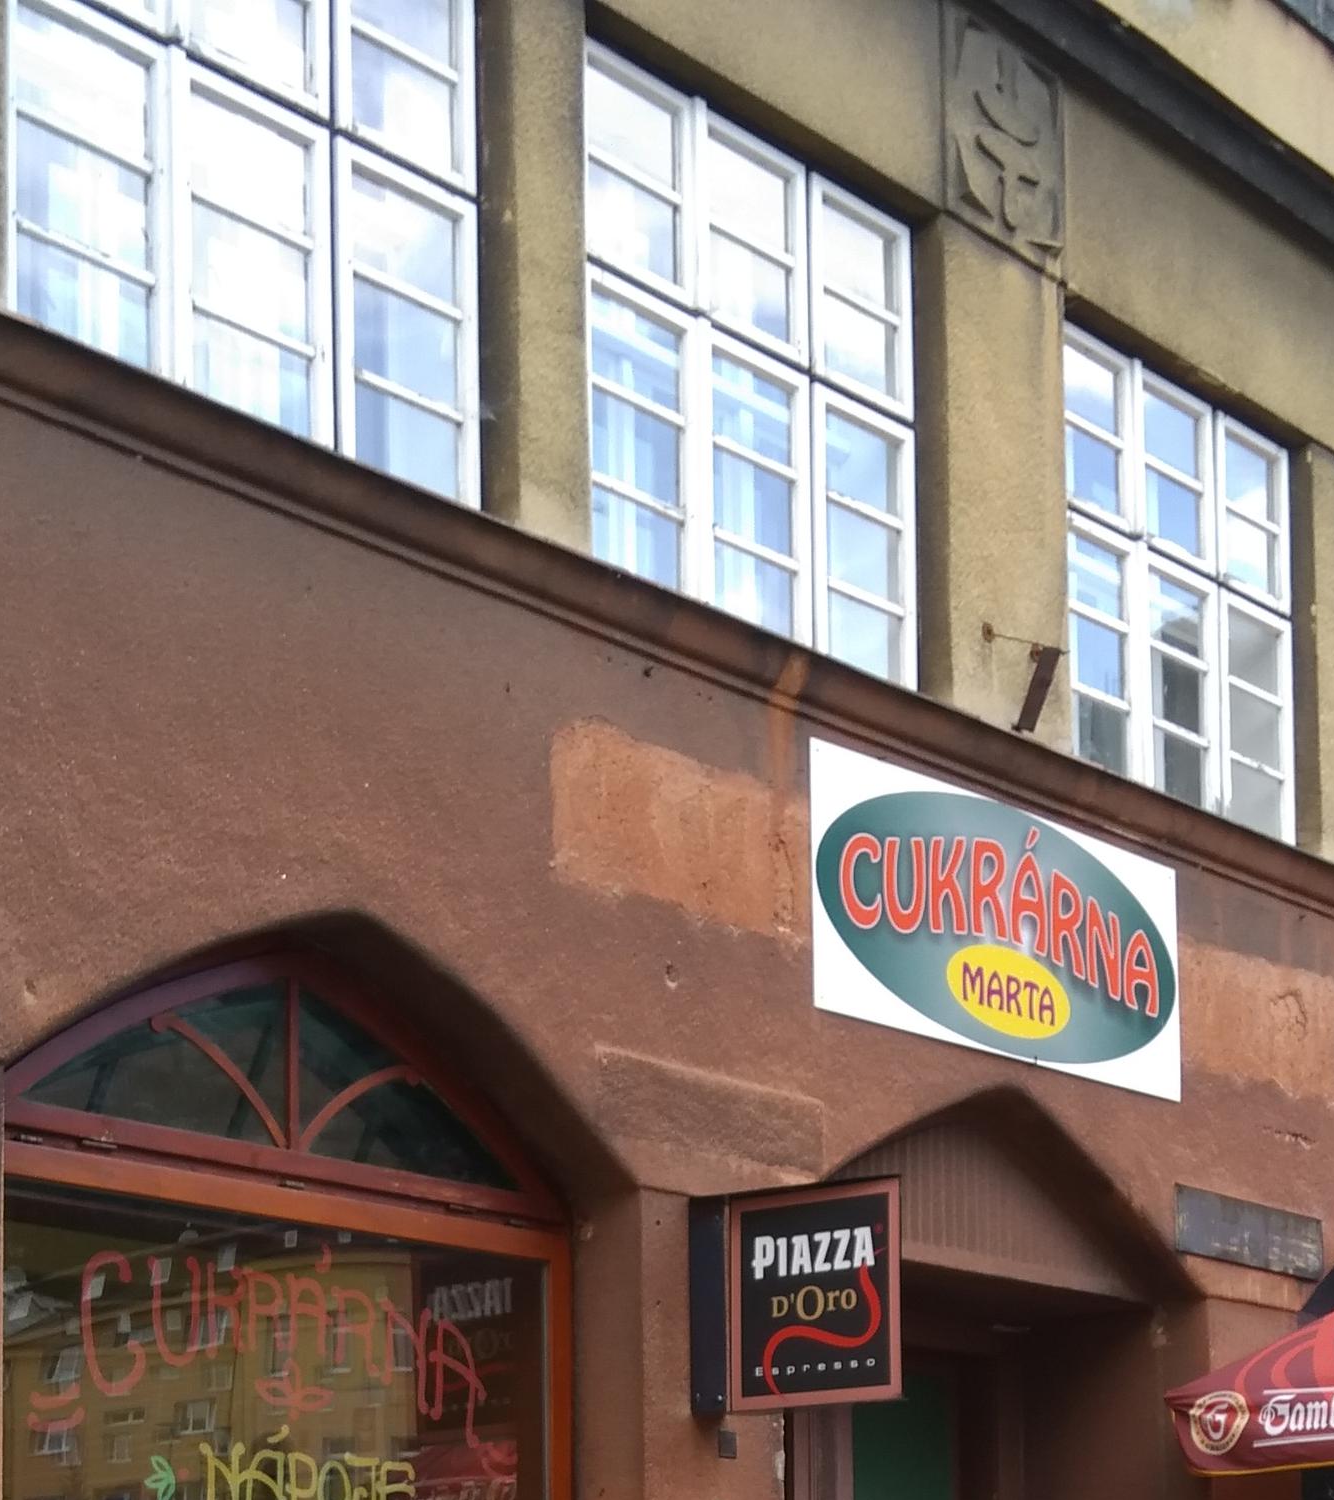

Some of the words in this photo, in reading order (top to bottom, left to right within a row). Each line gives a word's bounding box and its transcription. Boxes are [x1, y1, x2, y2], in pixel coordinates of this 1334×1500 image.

[839, 827, 1160, 1018] CUKRÁRNA
[961, 962, 1057, 1026] MARTA
[752, 1226, 875, 1280] PIAZZA
[80, 1243, 487, 1448] CUKRÁRNA
[755, 1357, 876, 1378] Espresso
